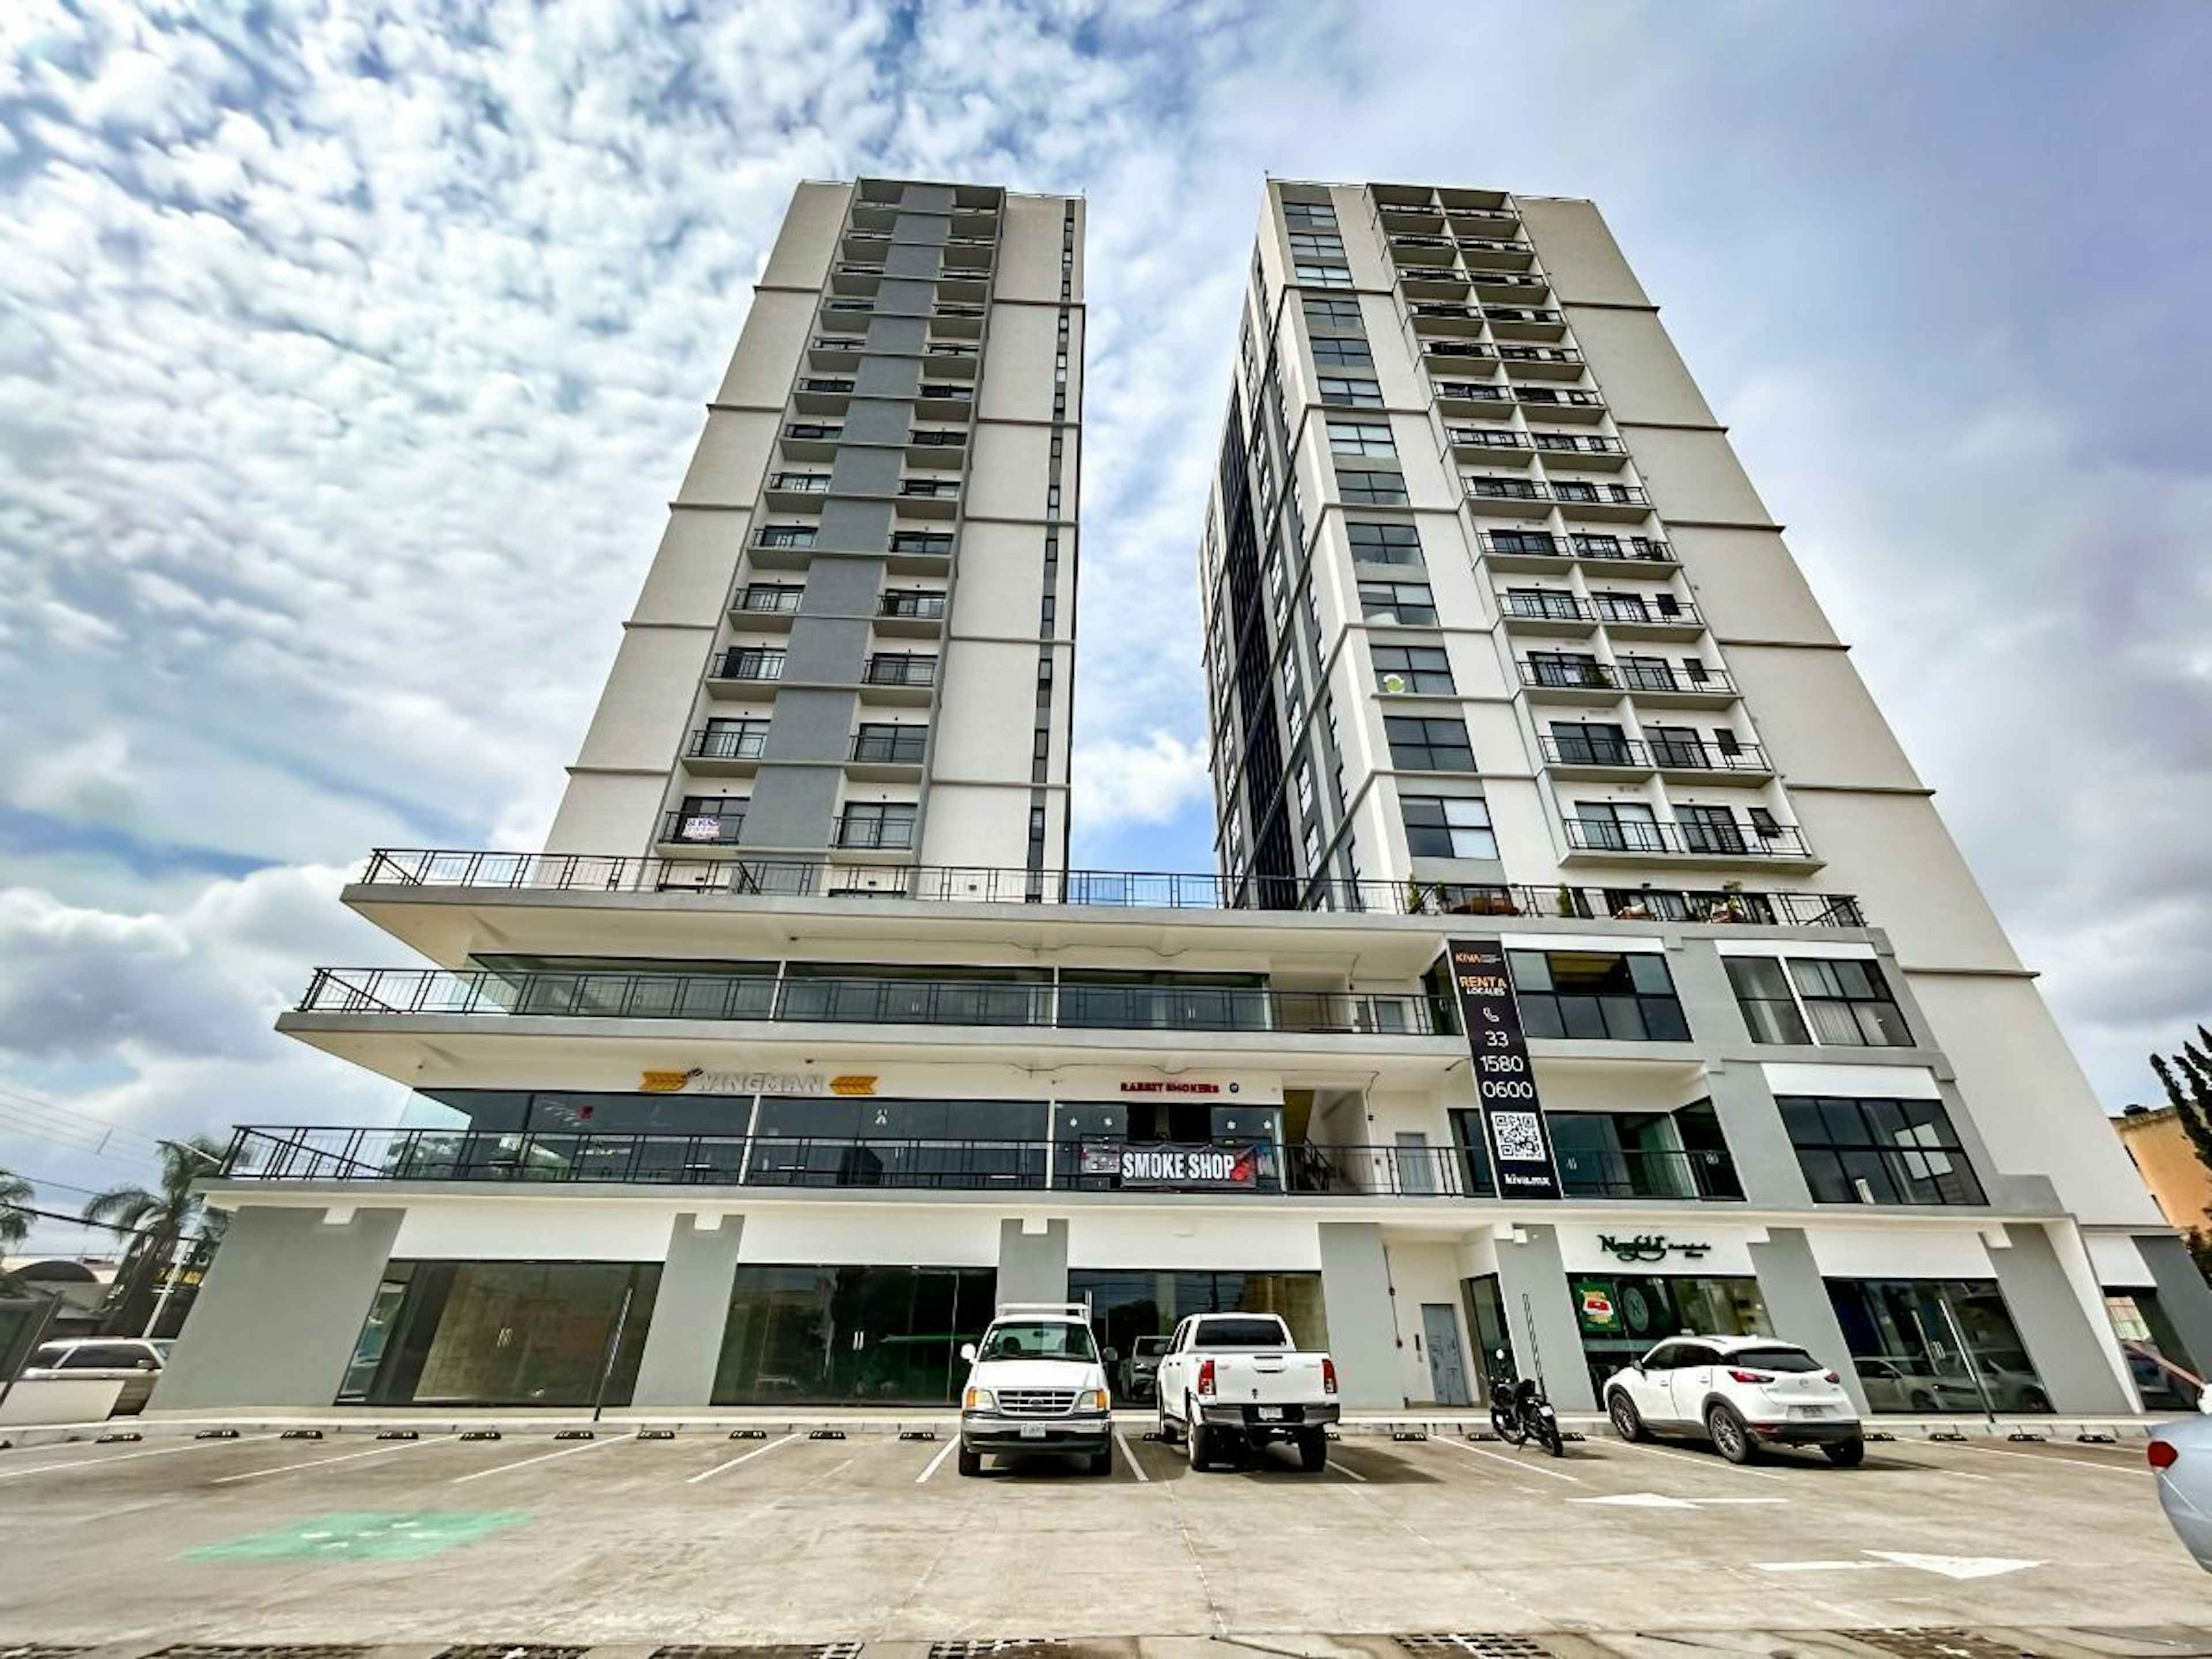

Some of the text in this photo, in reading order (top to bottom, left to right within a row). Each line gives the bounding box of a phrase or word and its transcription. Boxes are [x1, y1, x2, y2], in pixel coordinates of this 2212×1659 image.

[1455, 952, 1481, 964] KIVA
[1459, 976, 1507, 988] RENTA
[1466, 987, 1506, 997] LOCALES
[1484, 1030, 1509, 1048] 33
[1479, 1055, 1524, 1072] 1580
[696, 1073, 824, 1093] WINGMAN
[1120, 1082, 1219, 1093] RABBIT SMOKERS
[1482, 1081, 1533, 1099] 0600
[1123, 1152, 1185, 1180] SMOKE
[1188, 1153, 1235, 1180] SHOP
[1503, 1173, 1551, 1187] kiva.mx
